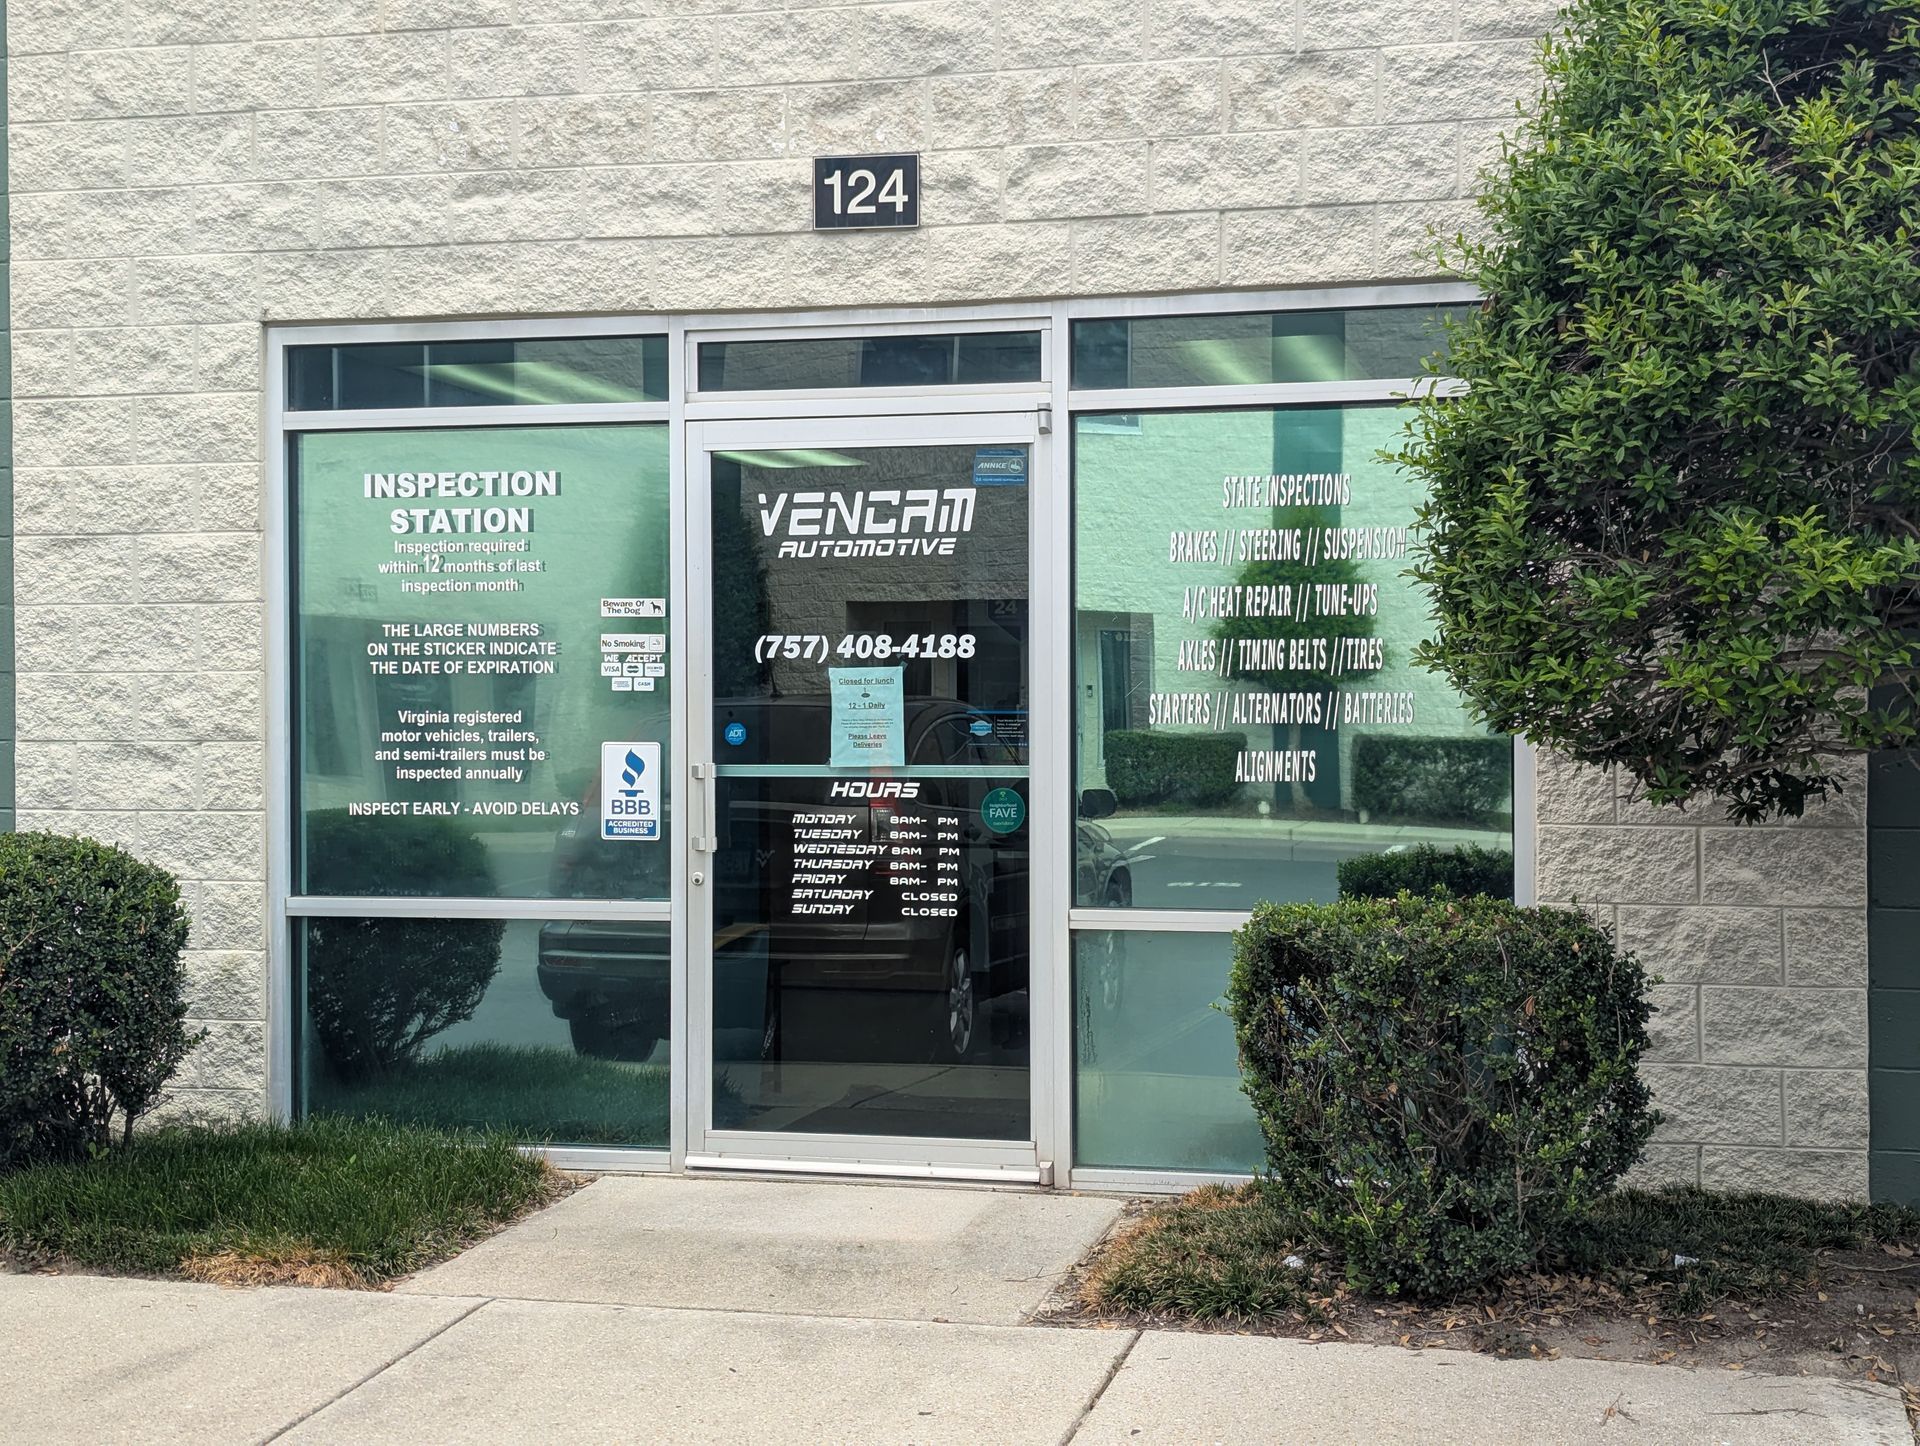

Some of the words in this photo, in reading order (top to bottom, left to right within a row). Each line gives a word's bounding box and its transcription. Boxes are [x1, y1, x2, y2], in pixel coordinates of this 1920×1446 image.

[824, 169, 909, 214] 124
[363, 471, 557, 498] INSPECTION
[1223, 476, 1262, 508] STATE
[1265, 473, 1351, 507] INSPECTIONS
[758, 488, 977, 536] VENCAM
[390, 508, 529, 533] STATION
[394, 540, 464, 557] Inspection
[468, 539, 525, 556] required
[778, 537, 957, 559] AUTOMOTIVE
[1170, 530, 1218, 562] BRAKES
[1221, 529, 1237, 566] //
[1239, 528, 1301, 561] STEERING
[1304, 527, 1320, 566] //
[1323, 527, 1407, 560] SUSPENSION
[378, 560, 418, 574] within
[422, 554, 440, 573] 12
[444, 560, 494, 573] months
[498, 559, 514, 572] of
[515, 559, 541, 572] last
[401, 579, 471, 594] inspection
[475, 578, 519, 591] month
[624, 607, 640, 615] Dog
[1182, 586, 1206, 624] A/C
[1210, 586, 1242, 617] HEAT
[1246, 585, 1292, 617] REPAIR
[1295, 583, 1311, 622] //
[1315, 583, 1378, 616] TUNE-UPS
[382, 624, 410, 637] THE
[414, 624, 463, 637] LARGE
[467, 623, 540, 637] NUMBERS
[367, 643, 389, 656] ON
[391, 643, 420, 656] THE
[423, 643, 485, 656] STICKER
[489, 642, 557, 655] INDICATE
[613, 640, 645, 649] Smoking
[755, 635, 829, 663] (757)
[836, 634, 976, 659] 408-4188
[604, 654, 619, 662] WE
[625, 654, 663, 662] ACCEPT
[1177, 640, 1216, 671] AXLES
[1219, 638, 1234, 677] //
[1239, 639, 1284, 671] TIMING
[1289, 638, 1327, 670] BELTS
[370, 661, 399, 674] THE
[402, 661, 440, 674] DATE
[444, 661, 463, 674] OF
[467, 661, 554, 674] EXPIRATION
[1149, 693, 1211, 725] STARTERS
[1214, 692, 1230, 730] //
[1232, 692, 1322, 724] ALTERNATORS
[1325, 691, 1340, 730] //
[1344, 692, 1414, 724] BATTERIES
[398, 711, 449, 726] Virginia
[453, 711, 522, 726] registered
[381, 731, 421, 742] motor
[424, 730, 484, 744] vehicles,
[488, 730, 540, 744] trailers,
[728, 729, 744, 738] ADT
[374, 748, 400, 761] and
[403, 748, 487, 761] semi-trailers
[491, 749, 525, 761] must
[528, 748, 546, 761] be
[1235, 750, 1316, 783] ALIGNMENTS
[396, 767, 462, 782] inspected
[466, 767, 523, 782] annually
[830, 781, 921, 798] HOURS
[349, 802, 409, 816] INSPECT
[413, 802, 460, 815] EARLY
[473, 802, 517, 815] AVOID
[522, 802, 580, 815] DELAYS
[611, 800, 651, 815] BBB
[989, 808, 1017, 818] FAVE
[792, 814, 857, 824] MONDAY
[937, 817, 959, 826] PM
[793, 829, 863, 839] TUESDAY
[937, 832, 959, 841] PM
[793, 844, 888, 855] WEDNESDAY
[891, 847, 922, 855] 8AM
[939, 848, 960, 856] PM
[793, 859, 874, 870] THURSDAY
[937, 863, 959, 872] PM
[791, 874, 847, 884] FRIDAY
[937, 878, 959, 887] PM
[791, 889, 874, 900] SATURDAY
[901, 892, 958, 902] CLOSED
[791, 904, 855, 915] SUNDAY
[901, 908, 958, 917] CLOSED
